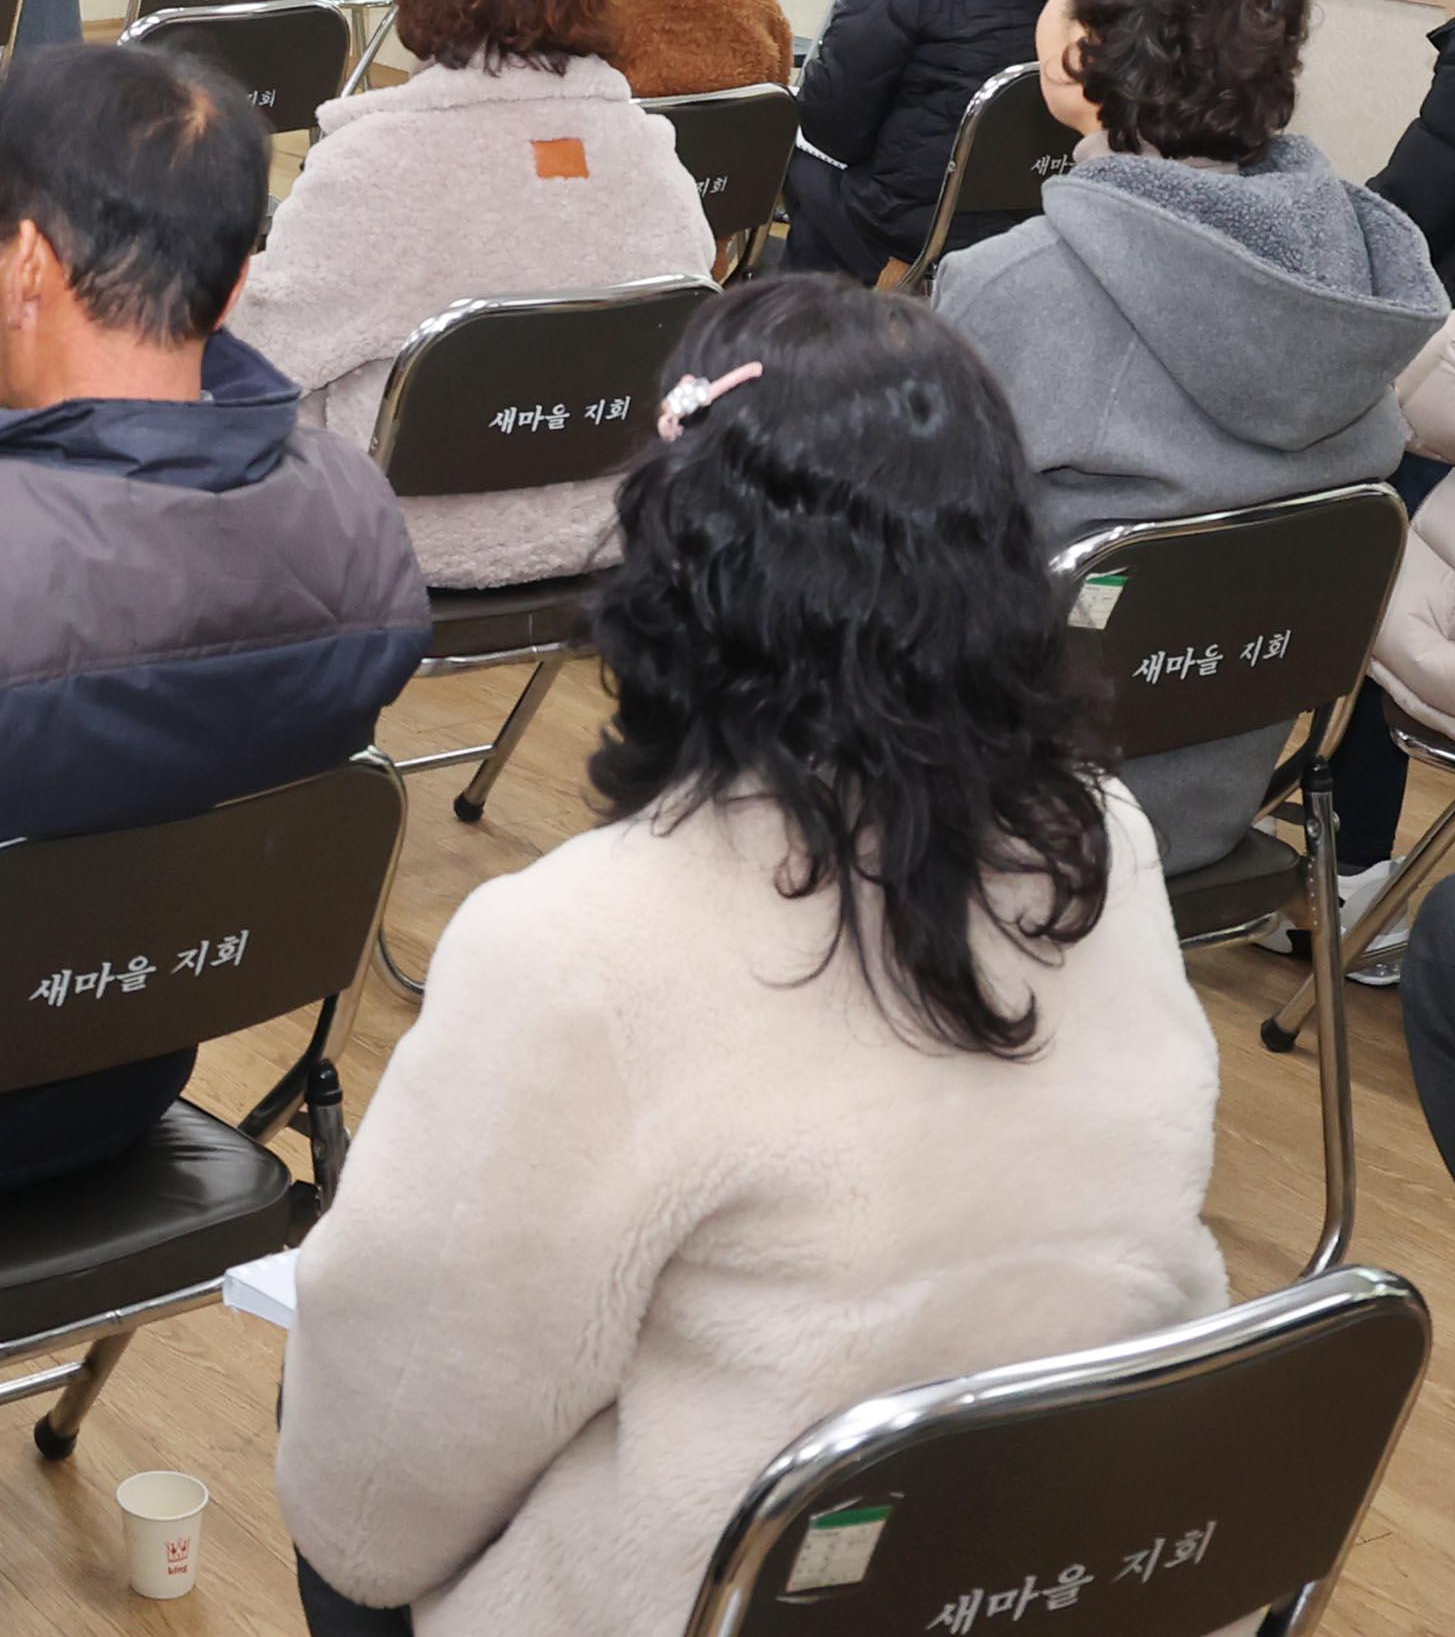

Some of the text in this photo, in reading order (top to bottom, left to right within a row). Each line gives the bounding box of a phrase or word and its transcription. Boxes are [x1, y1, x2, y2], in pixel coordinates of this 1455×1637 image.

[1031, 154, 1076, 176] 새마
[488, 395, 631, 435] 새마을 지회
[1132, 629, 1292, 685] 새마을 지회
[28, 929, 249, 1008] 새마을 지회
[926, 1520, 1217, 1635] 새마을 지회
